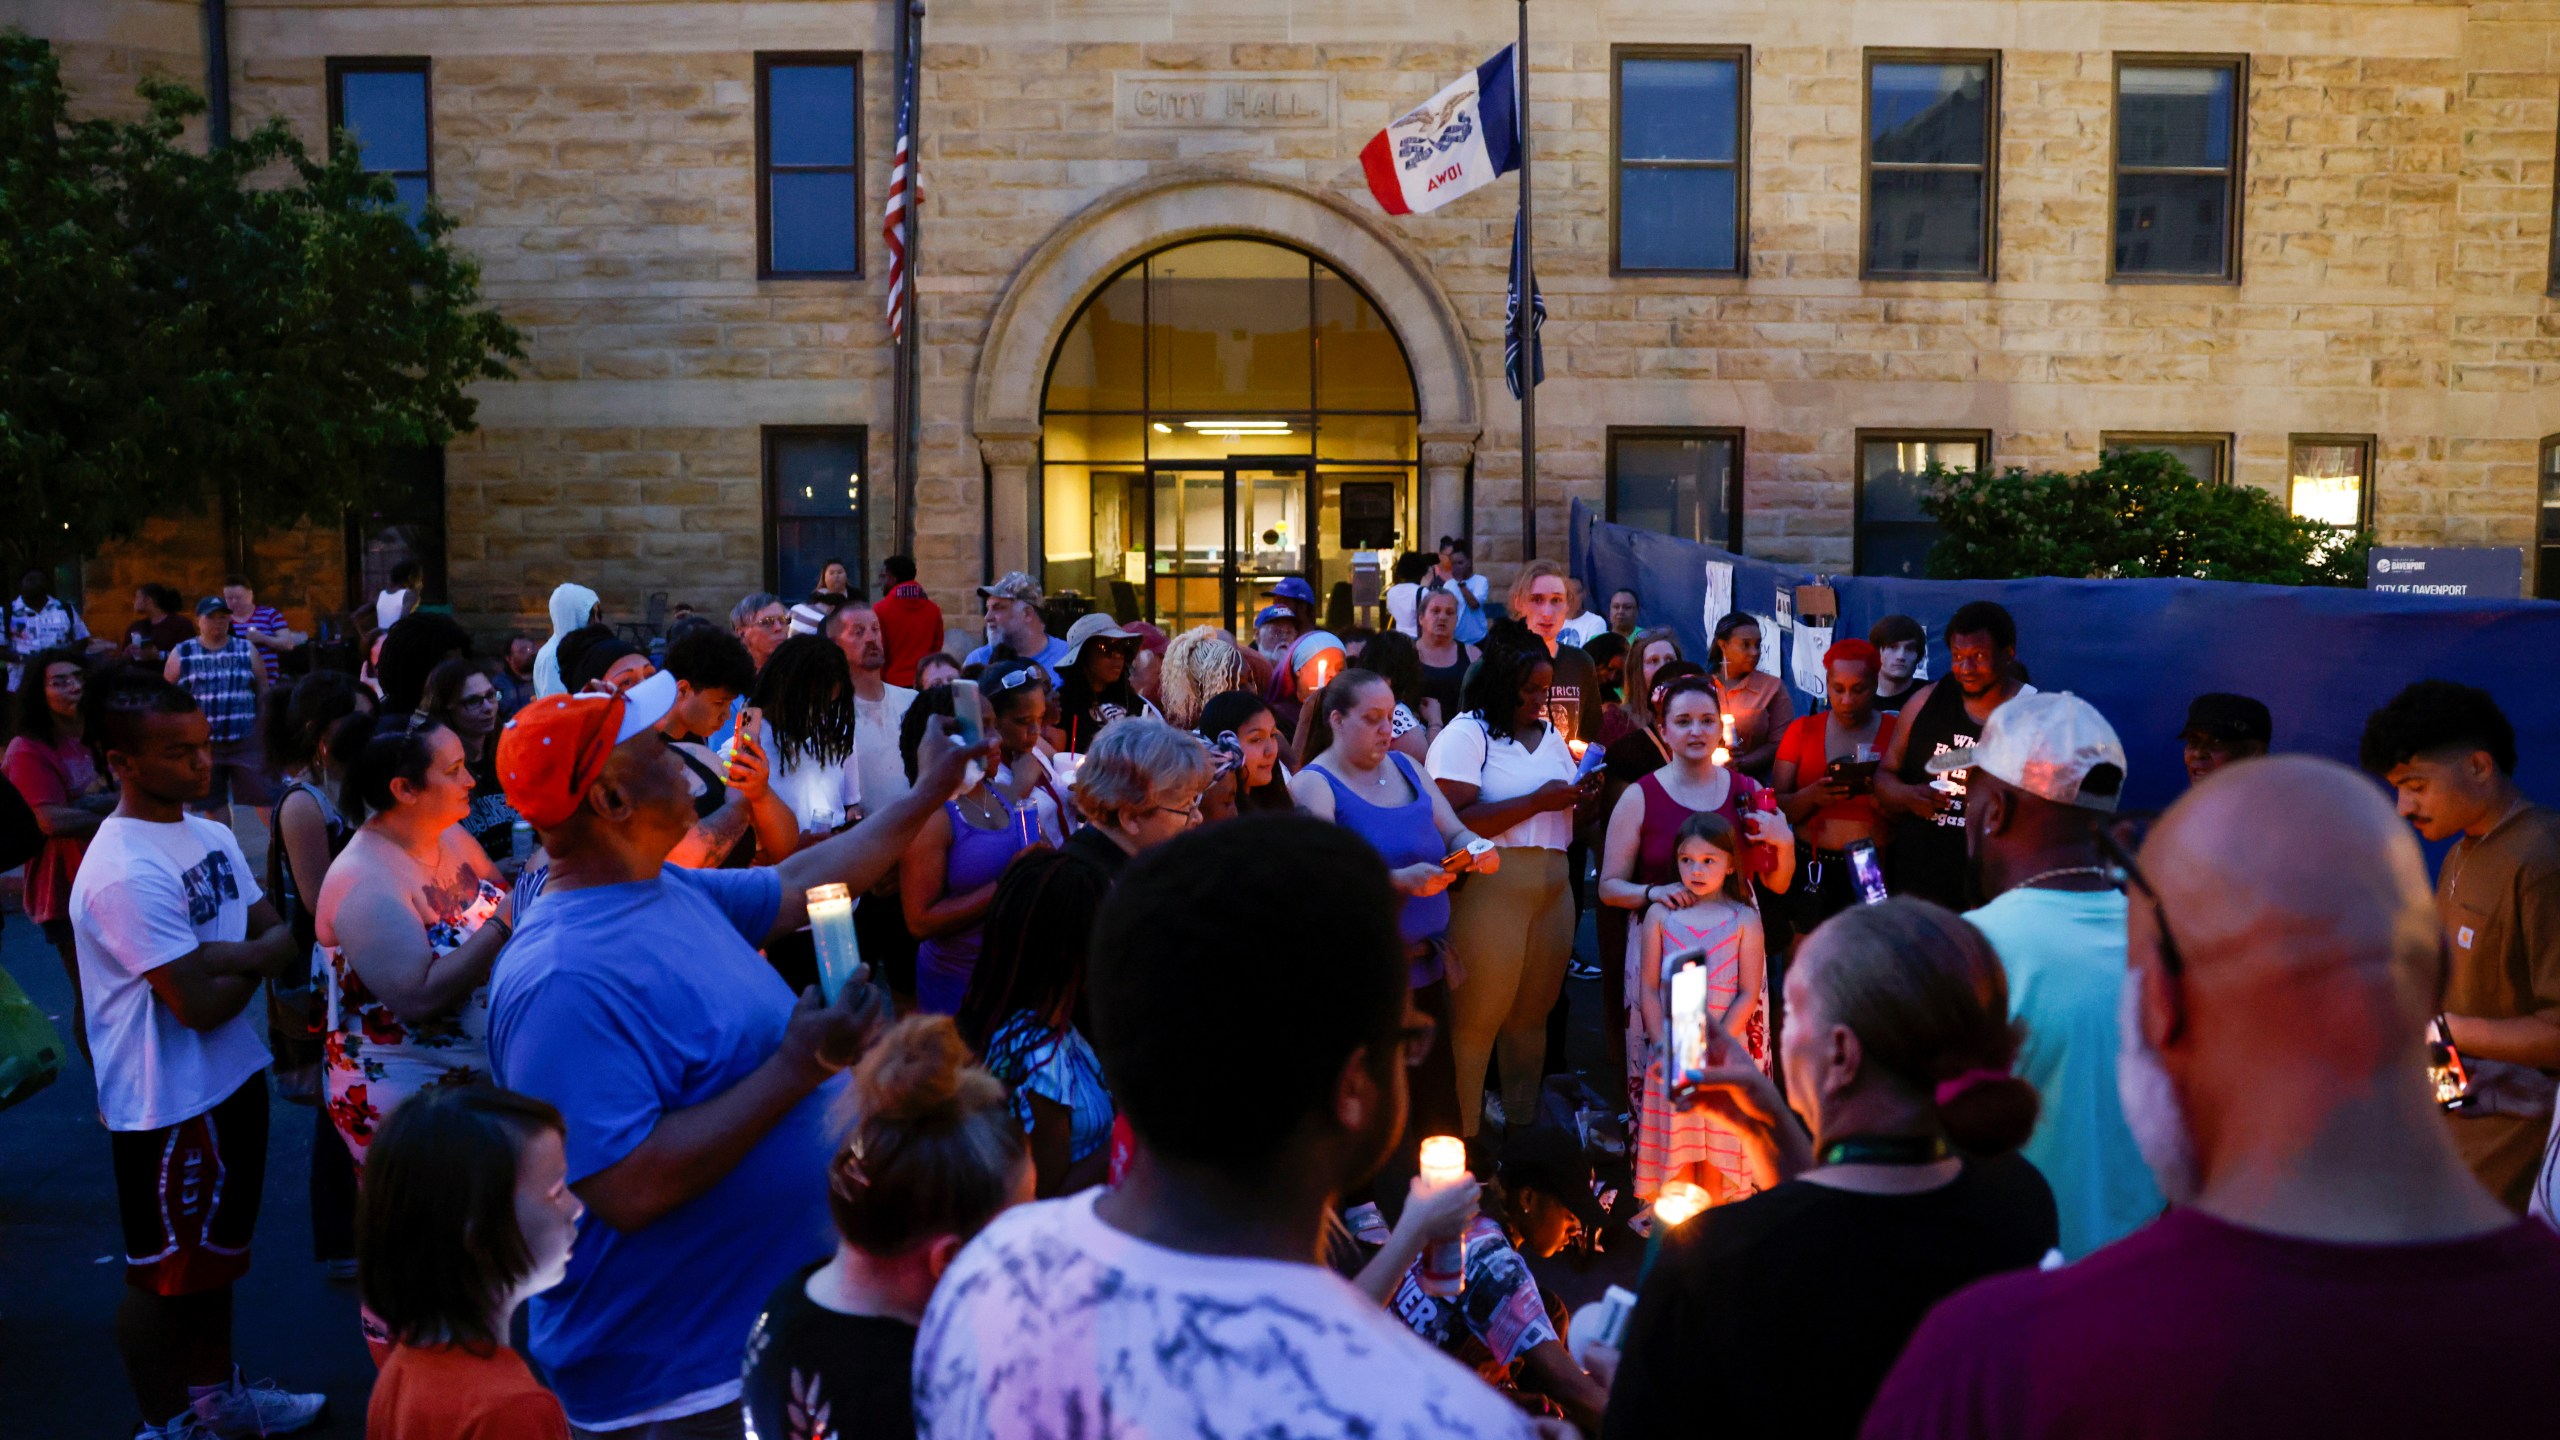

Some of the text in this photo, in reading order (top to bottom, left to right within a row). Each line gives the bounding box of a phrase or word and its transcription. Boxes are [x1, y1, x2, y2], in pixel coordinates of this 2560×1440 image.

[1134, 84, 1206, 119] CITY
[2391, 561, 2426, 570] DAVENPORT
[2375, 584, 2468, 596] CITY OF DAVENPORT
